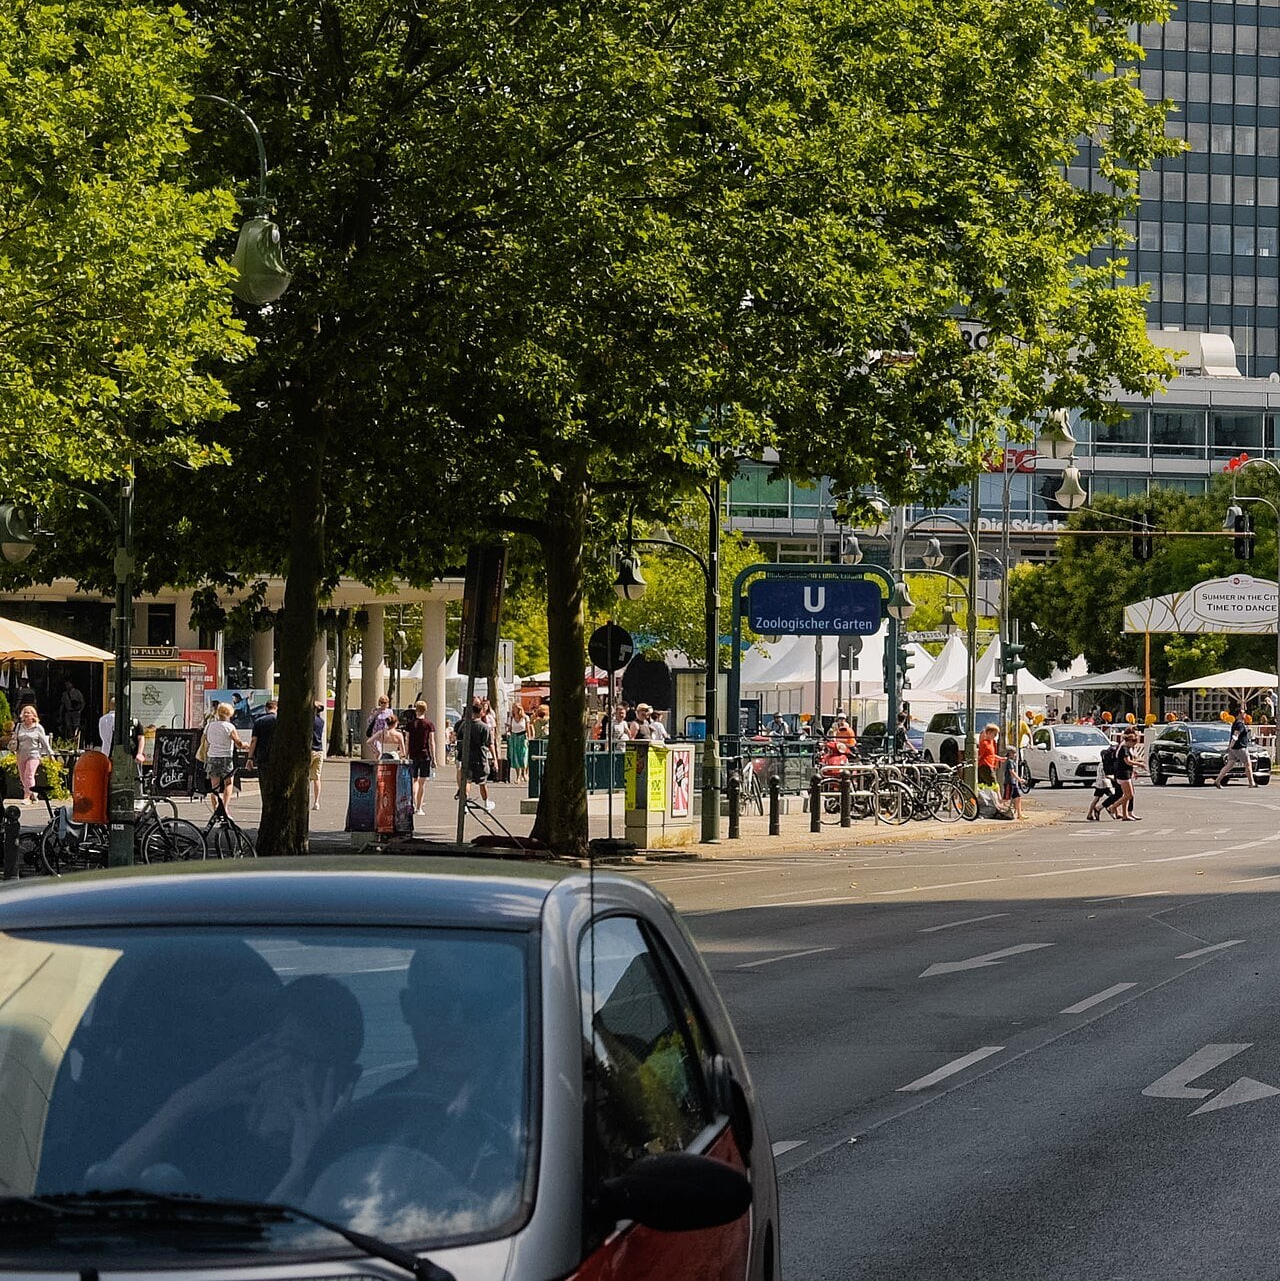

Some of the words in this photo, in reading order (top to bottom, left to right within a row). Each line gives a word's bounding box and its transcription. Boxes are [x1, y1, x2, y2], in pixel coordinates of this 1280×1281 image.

[803, 586, 826, 613] U
[1202, 593, 1236, 601] SUMMER
[1207, 603, 1230, 611] TIME
[1245, 604, 1277, 612] DANCE
[756, 617, 829, 632] Zoologischer
[833, 617, 873, 631] Garten
[159, 736, 190, 756] Coffee
[160, 772, 185, 788] Cake
